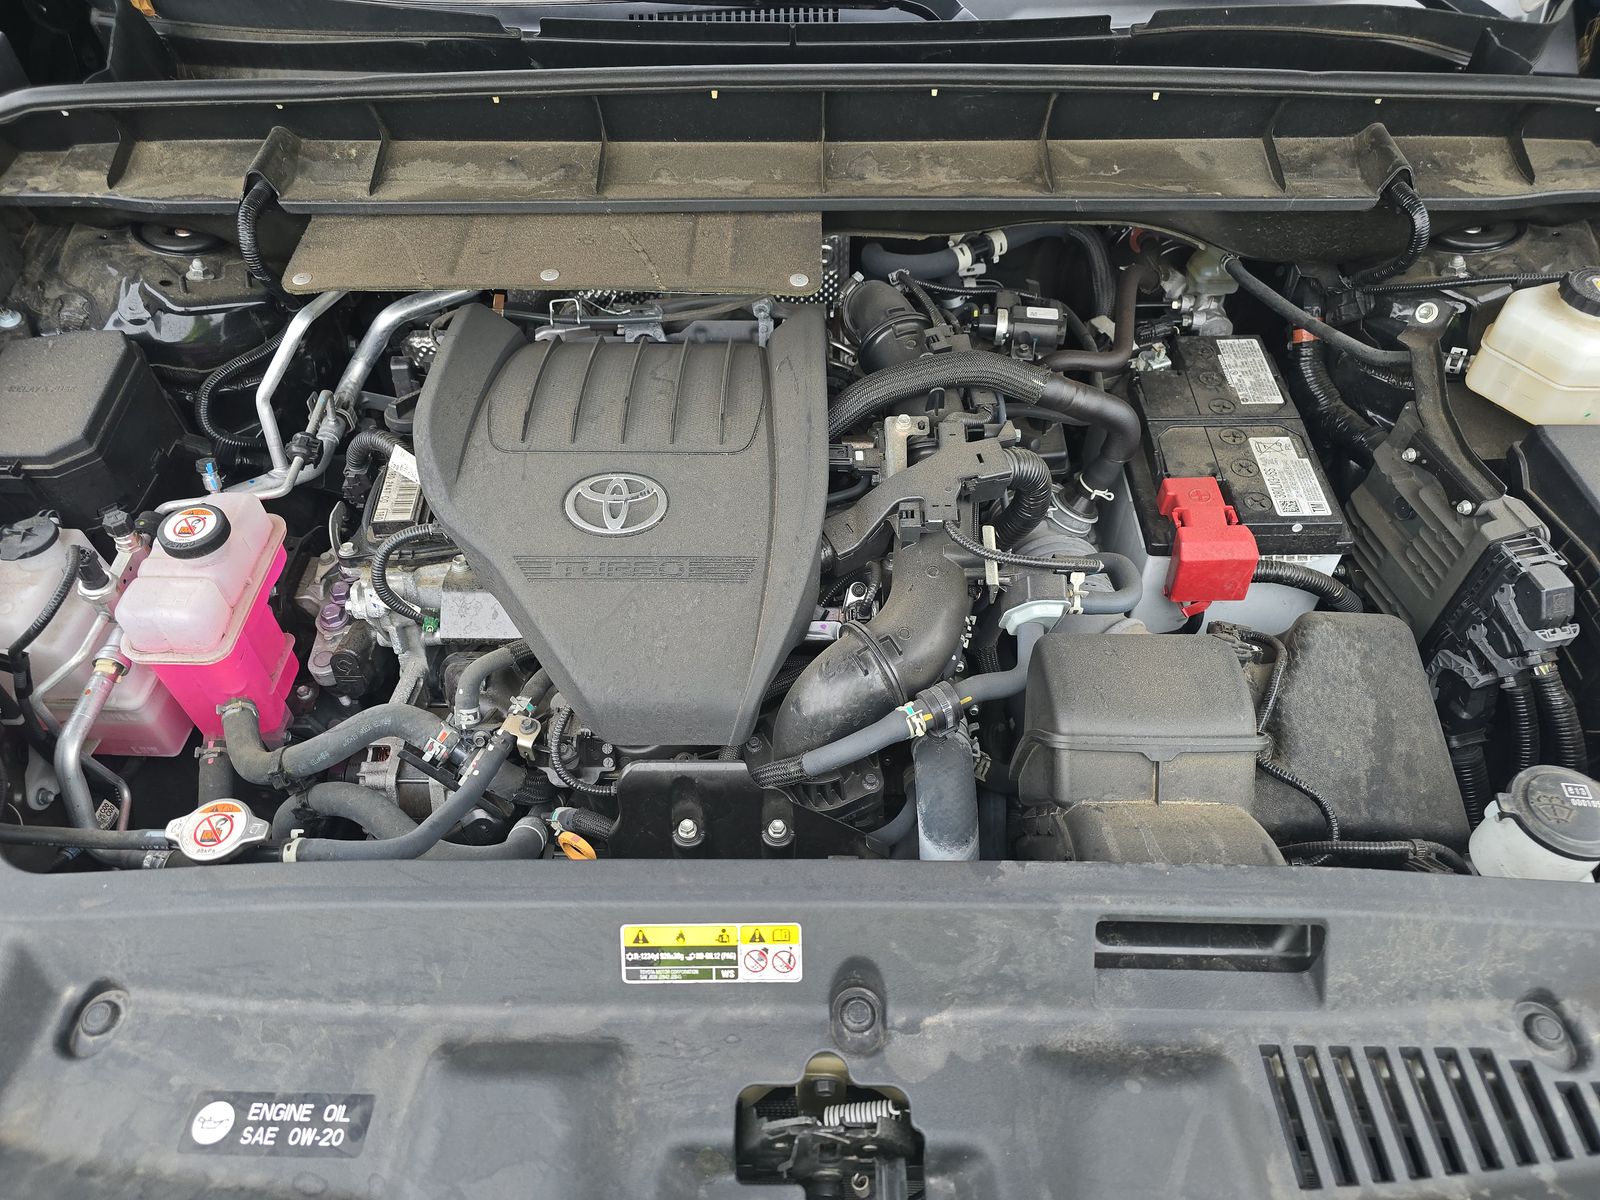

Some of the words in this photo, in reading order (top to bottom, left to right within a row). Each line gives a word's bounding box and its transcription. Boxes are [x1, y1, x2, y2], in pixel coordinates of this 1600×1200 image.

[555, 561, 685, 578] TURBO
[247, 1102, 315, 1122] ENGINE
[323, 1104, 350, 1123] OIL
[240, 1126, 279, 1145] SAE
[287, 1127, 345, 1147] 0W-20
